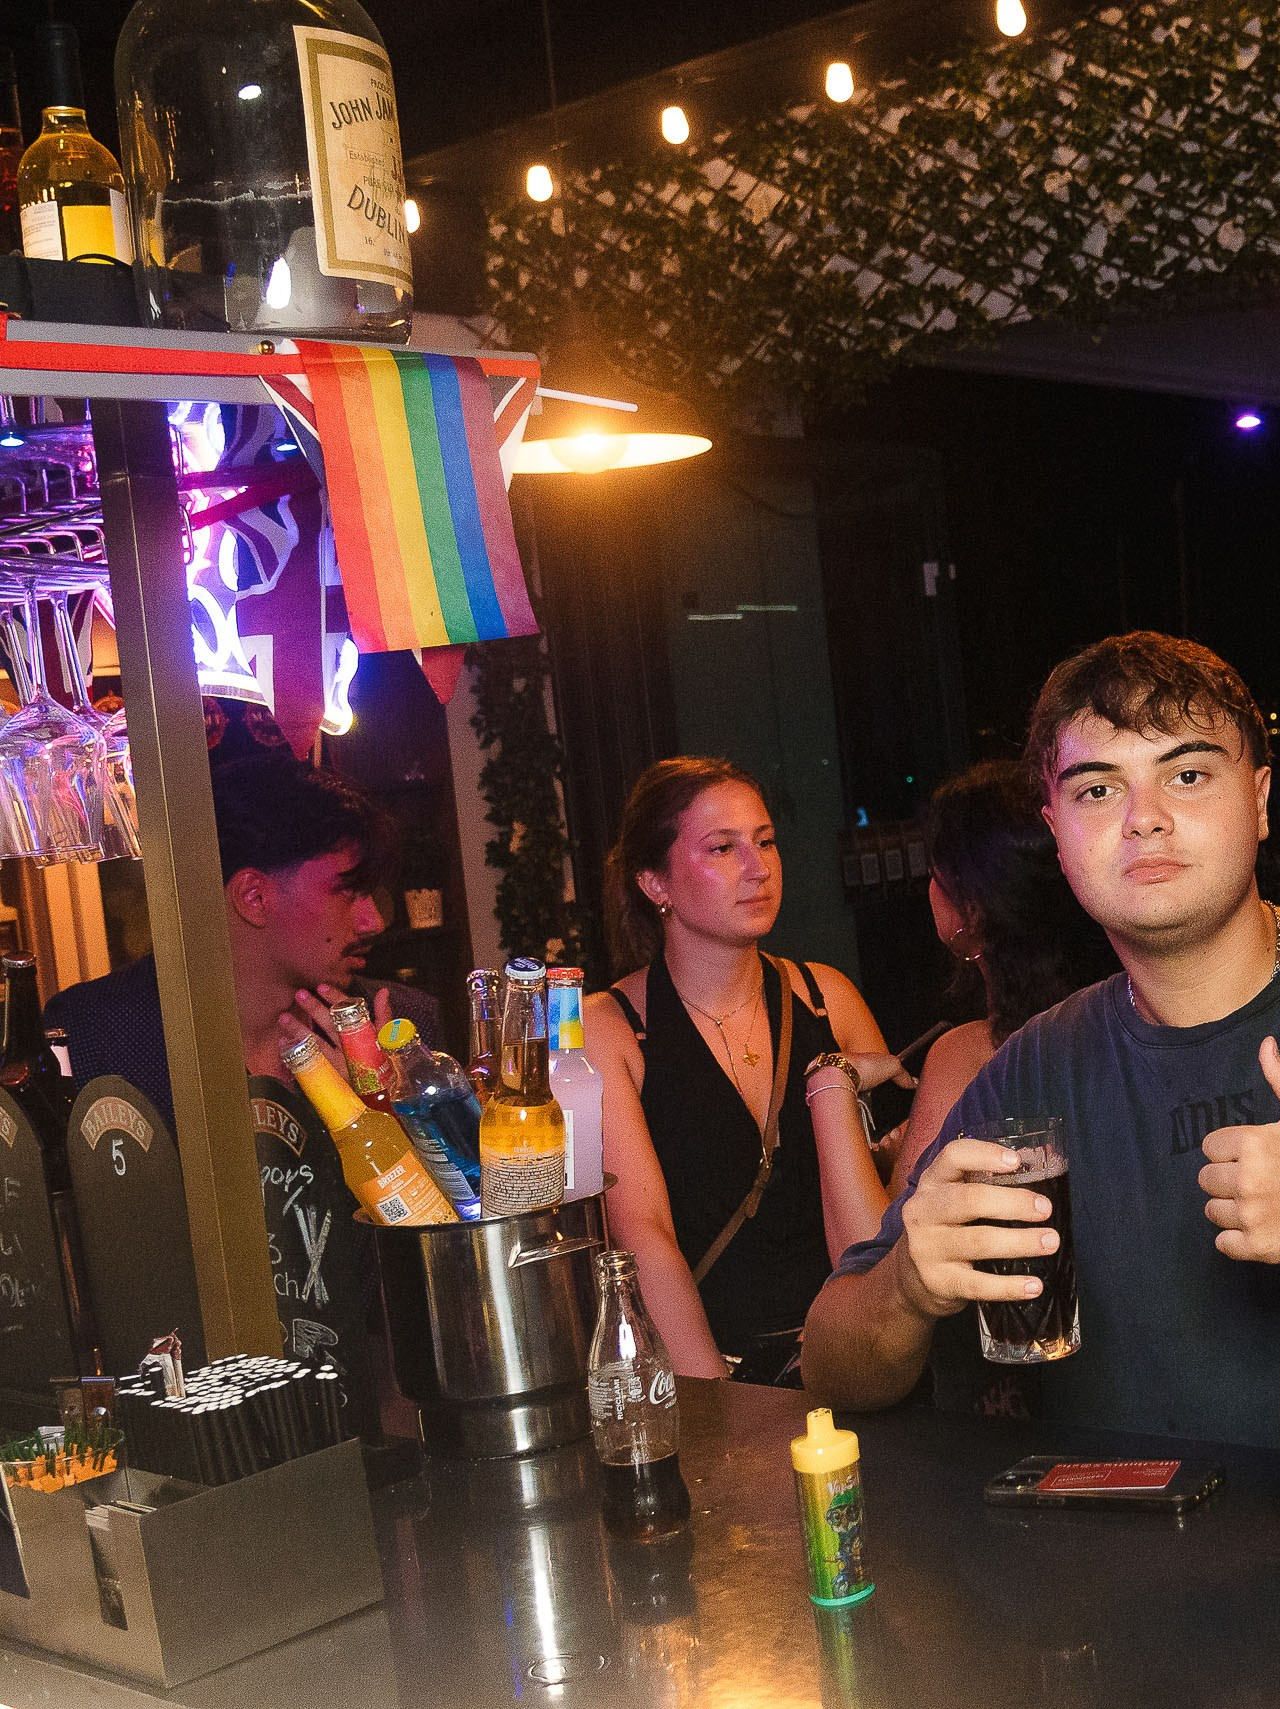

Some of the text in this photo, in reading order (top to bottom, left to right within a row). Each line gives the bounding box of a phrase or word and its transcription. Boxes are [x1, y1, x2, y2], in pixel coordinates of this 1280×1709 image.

[329, 97, 373, 130] JOHN
[347, 184, 406, 246] DUBLIN
[86, 1101, 147, 1138] BAILEYS
[253, 1104, 299, 1142] LEYS
[112, 1139, 126, 1176] 5
